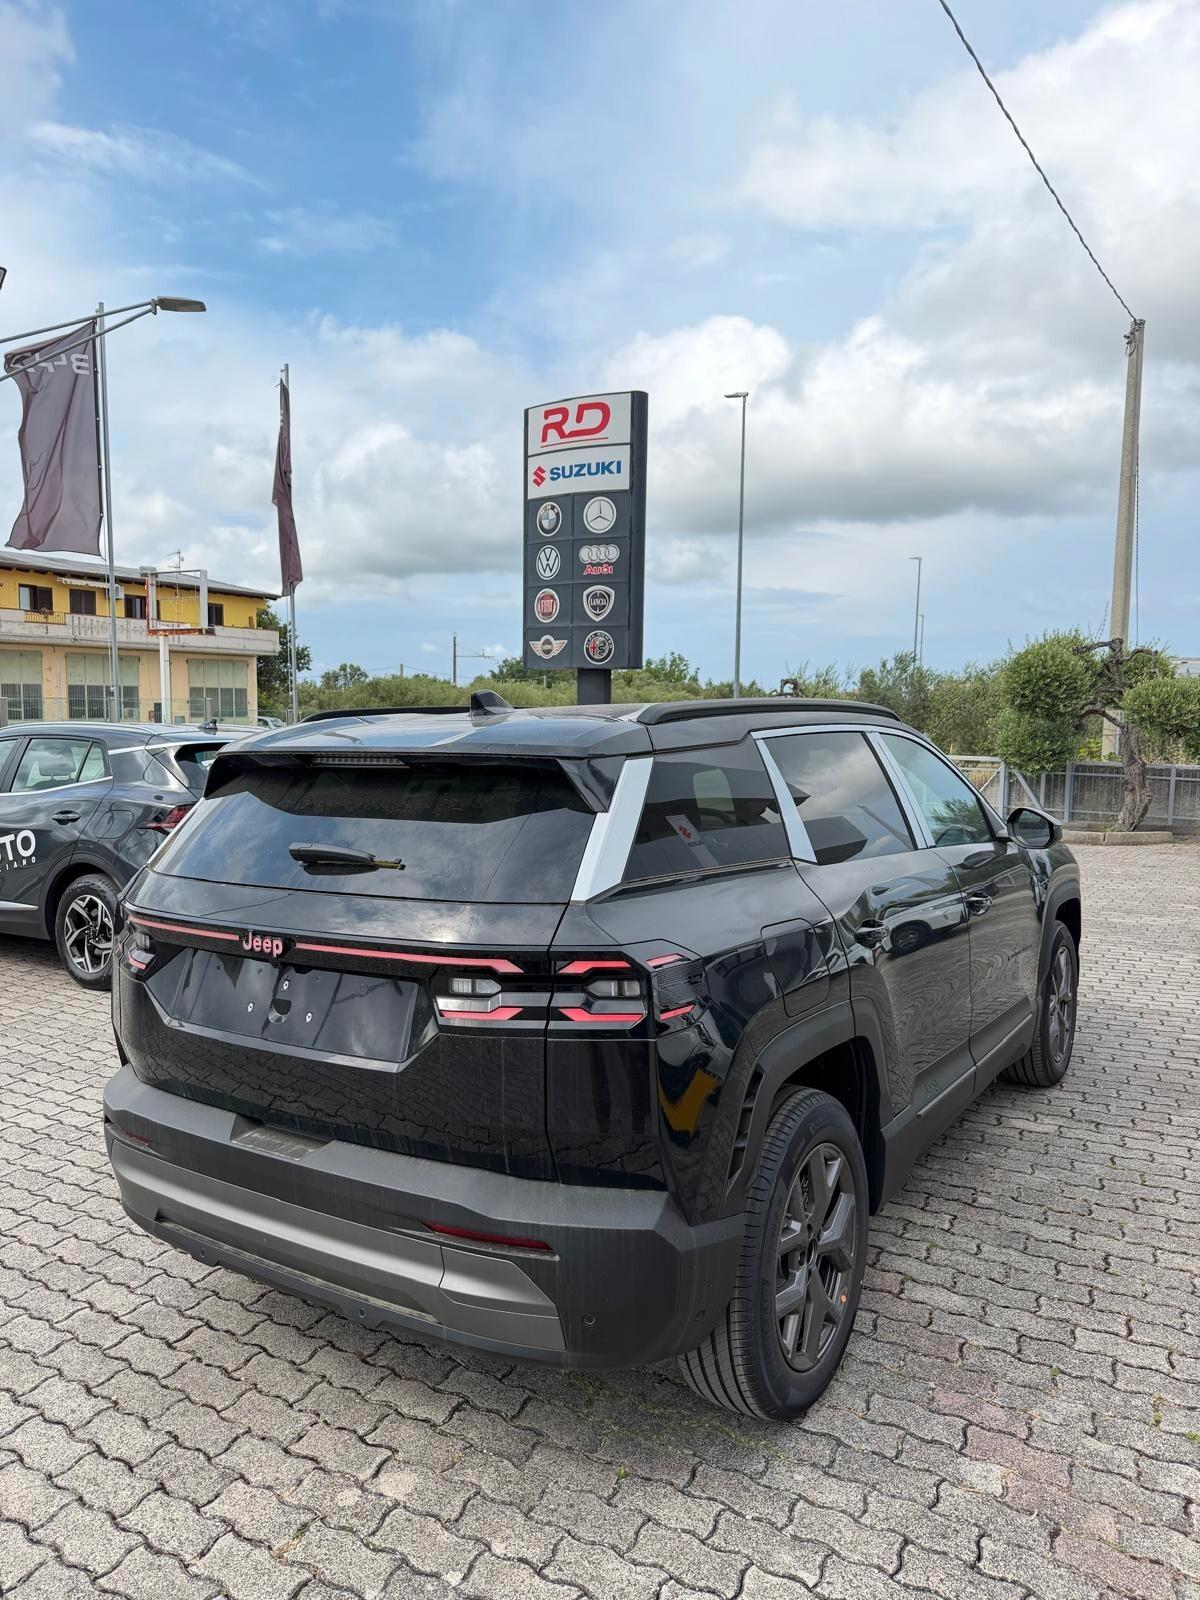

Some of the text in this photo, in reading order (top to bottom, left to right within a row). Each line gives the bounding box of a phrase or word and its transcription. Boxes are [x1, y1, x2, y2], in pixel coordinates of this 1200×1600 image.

[541, 402, 610, 443] RD
[550, 460, 621, 481] SUZUKI
[583, 564, 613, 575] Audi
[590, 598, 606, 606] LANCIA
[0, 830, 36, 862] TO
[241, 931, 283, 958] Jeep
